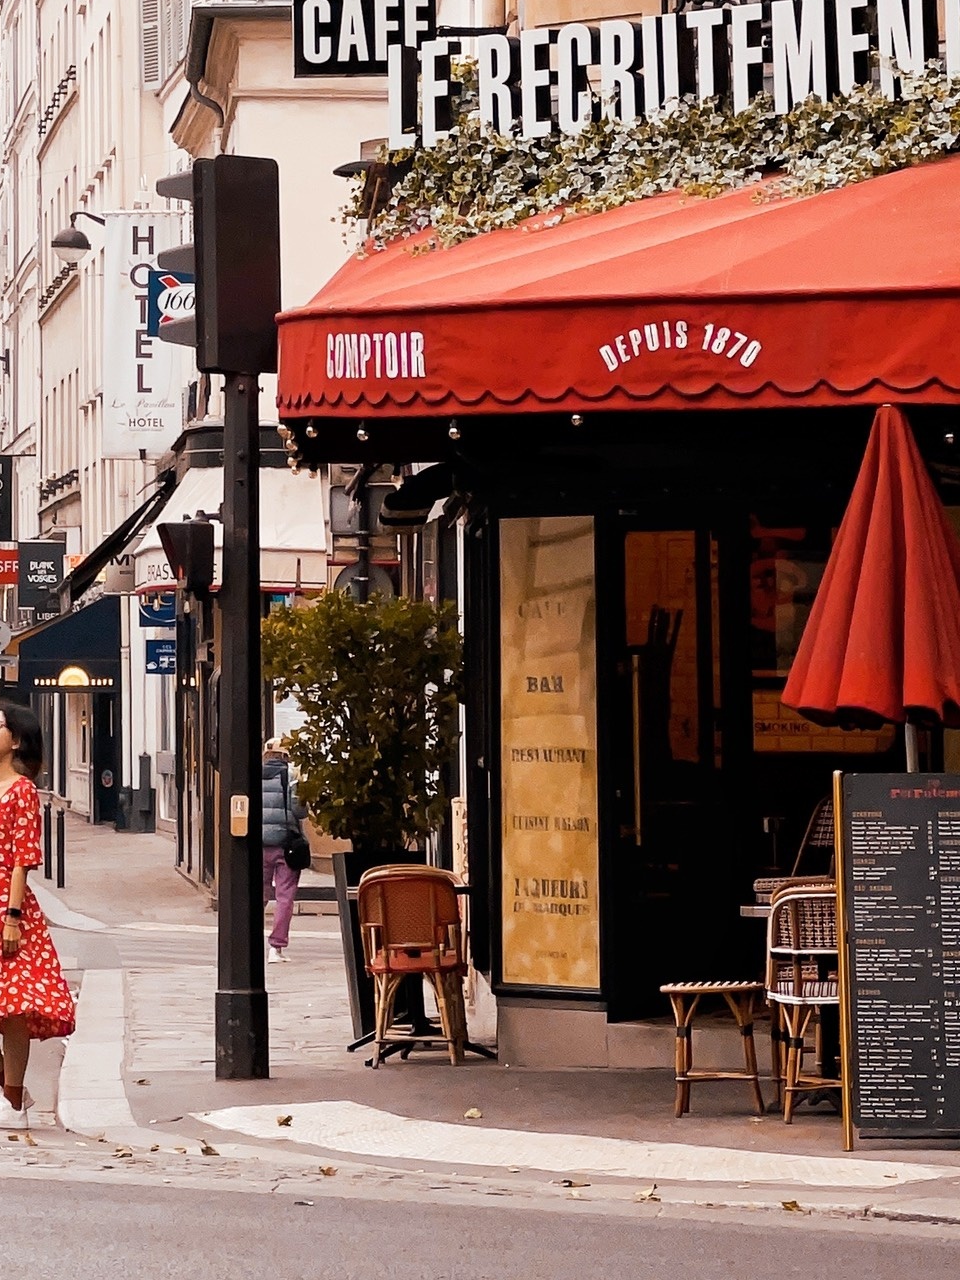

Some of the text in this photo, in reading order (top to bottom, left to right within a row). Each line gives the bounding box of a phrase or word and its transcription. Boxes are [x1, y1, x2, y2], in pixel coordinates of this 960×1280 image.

[388, 40, 449, 151] LE
[164, 290, 195, 310] 166
[326, 331, 426, 379] COMPTOIR
[598, 320, 762, 372] DEPUIS 1870
[129, 418, 164, 428] HOTEL
[27, 574, 57, 583] VOSGES
[512, 747, 586, 764] RESTAURANT
[514, 877, 589, 900] LIQUEURS
